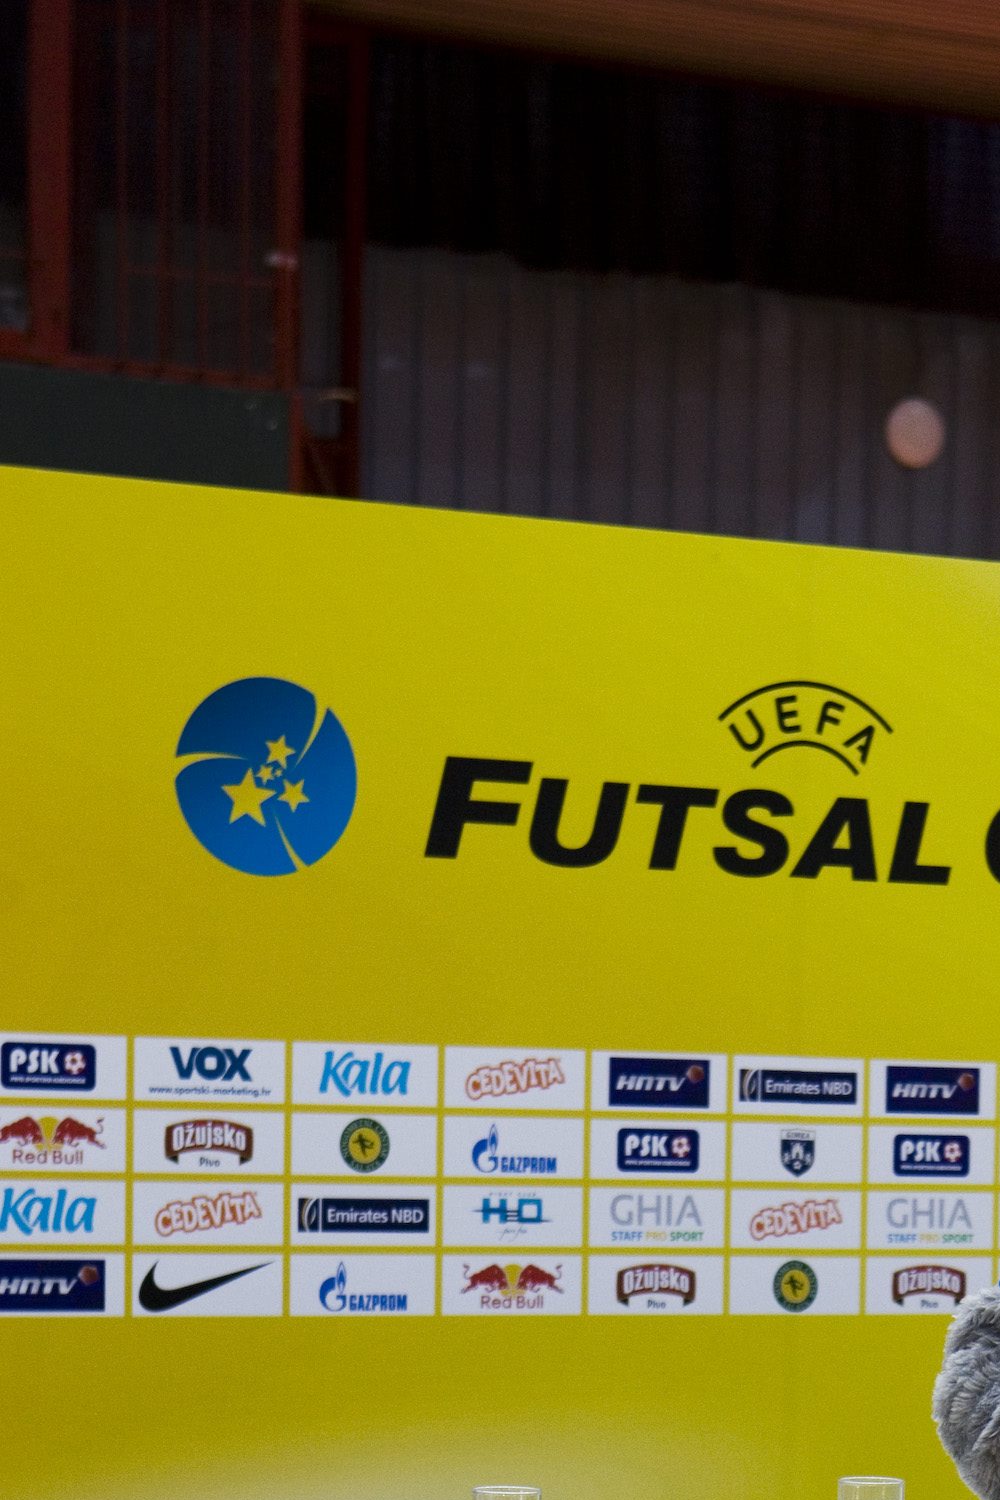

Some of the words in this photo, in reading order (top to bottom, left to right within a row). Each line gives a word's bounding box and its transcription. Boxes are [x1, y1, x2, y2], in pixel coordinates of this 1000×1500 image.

[729, 694, 878, 766] UEFA
[423, 755, 953, 887] FUTSAL
[9, 1049, 59, 1075] PSK
[169, 1046, 253, 1082] VOX
[319, 1051, 411, 1097] Kala
[466, 1058, 566, 1101] CEDEVITA
[765, 1079, 820, 1095] Emirates
[823, 1082, 852, 1096] NBD
[172, 1119, 247, 1151] Ožujsko
[624, 1135, 668, 1157] PSK
[12, 1150, 48, 1165] Red
[53, 1149, 84, 1165] Bull
[901, 1140, 942, 1162] PSK
[501, 1157, 557, 1174] GAZPROM
[0, 1187, 97, 1236] Kala
[154, 1192, 262, 1237] CEDEVITA
[327, 1208, 388, 1224] Emirates
[391, 1209, 424, 1224] NBD
[609, 1193, 703, 1227] GHIA
[750, 1199, 843, 1241] CEDEVITA
[885, 1198, 973, 1229] GHIA
[611, 1231, 643, 1242] STAFF
[669, 1231, 704, 1242] SPORT
[888, 1233, 917, 1243] STAFF
[942, 1233, 974, 1243] SPORT
[350, 1294, 407, 1311] GAZPROM
[480, 1295, 512, 1309] Red
[517, 1295, 544, 1309] Bull
